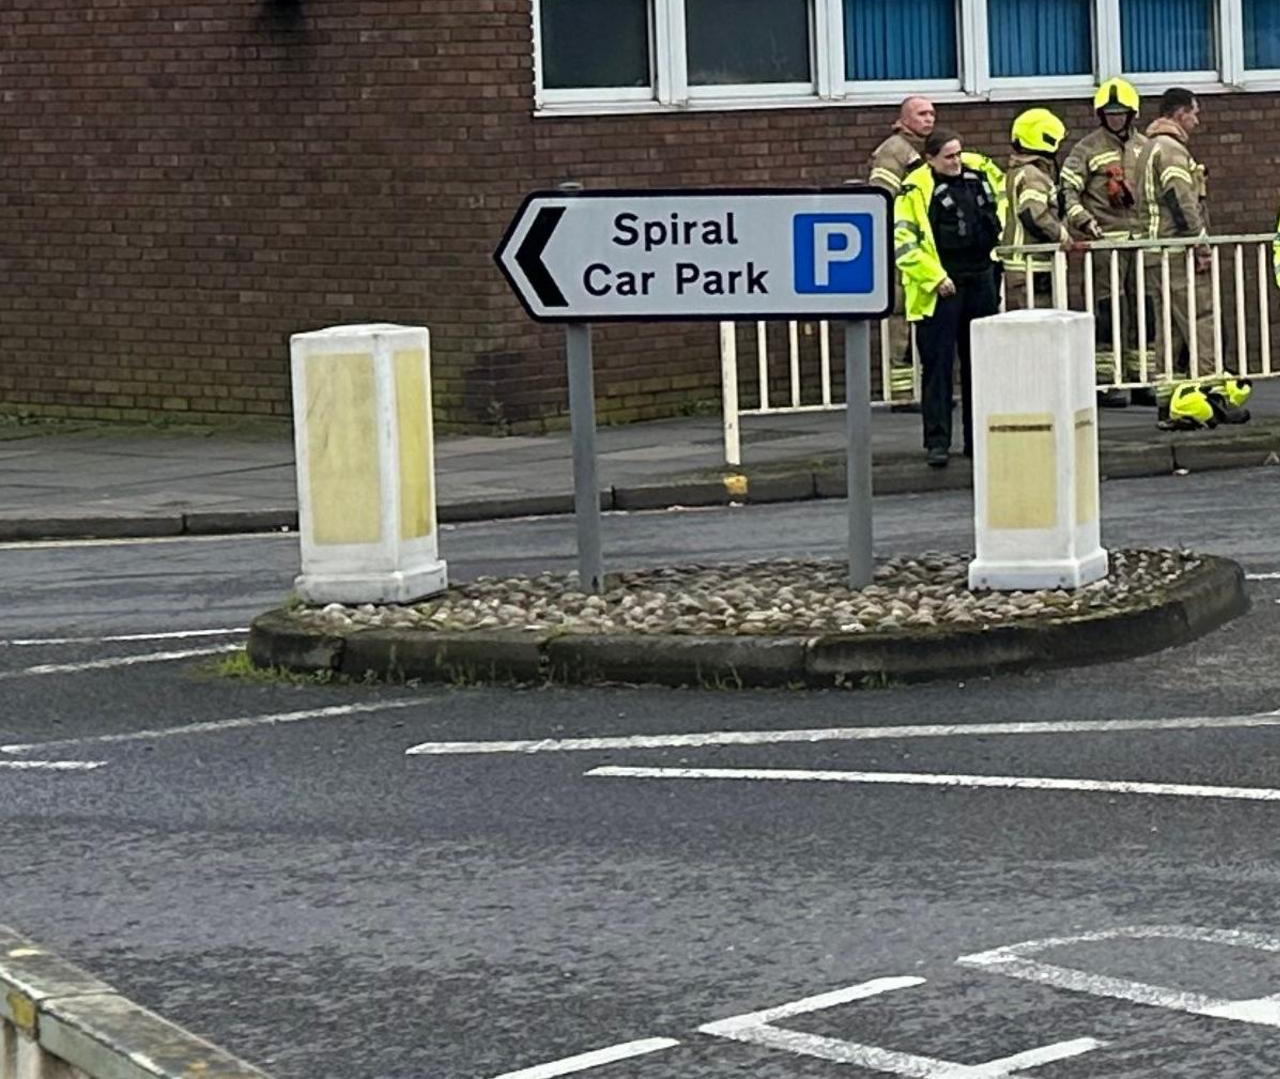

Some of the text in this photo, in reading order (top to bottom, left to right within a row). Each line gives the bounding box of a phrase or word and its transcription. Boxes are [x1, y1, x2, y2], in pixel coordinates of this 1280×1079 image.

[612, 212, 739, 251] Spiral
[813, 222, 862, 286] P
[583, 262, 768, 296] Car Park
